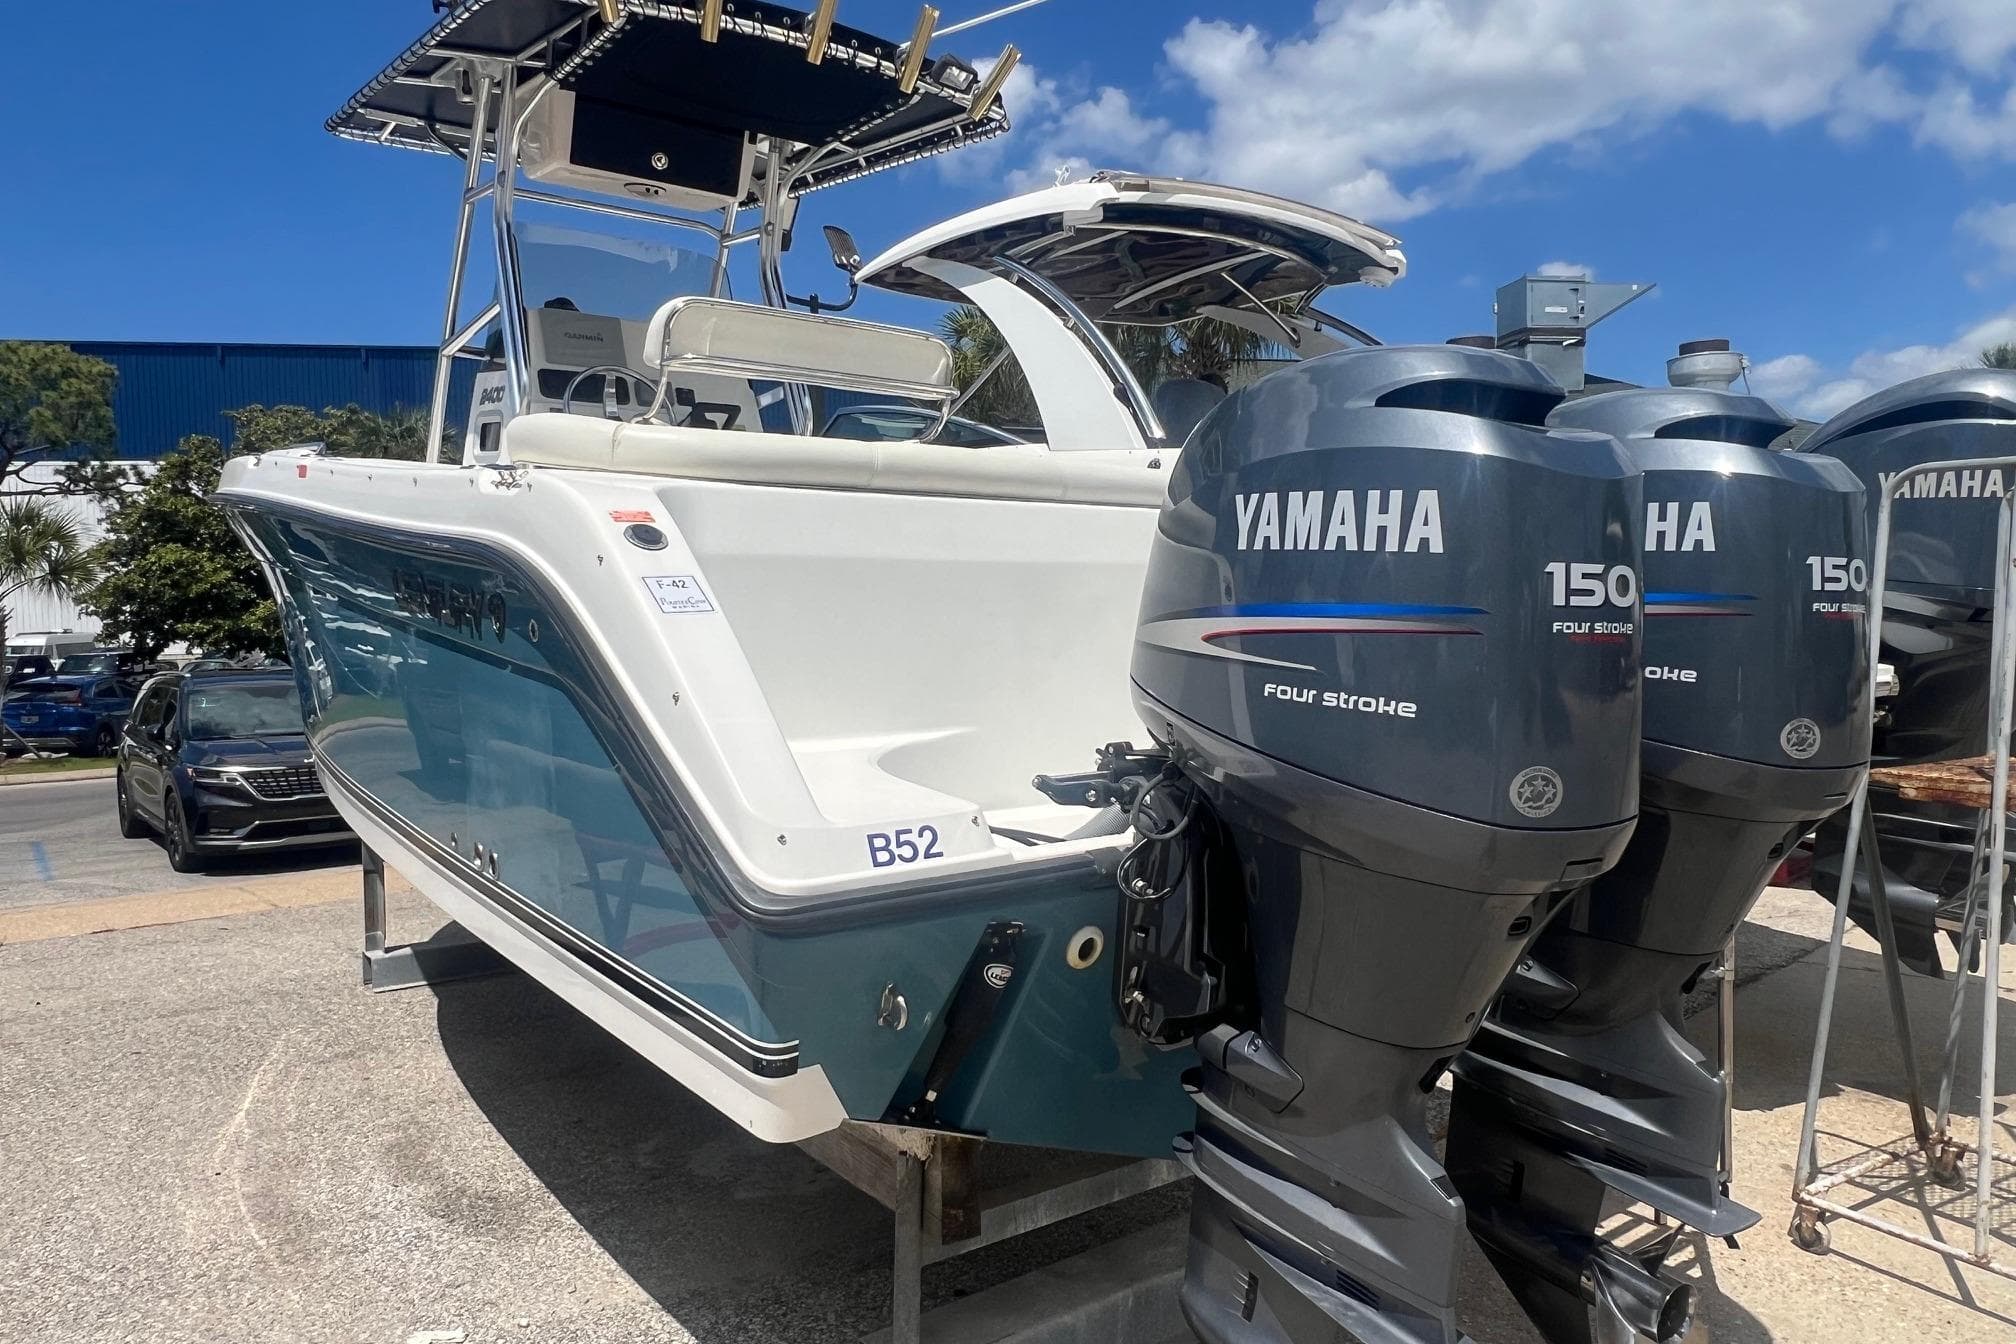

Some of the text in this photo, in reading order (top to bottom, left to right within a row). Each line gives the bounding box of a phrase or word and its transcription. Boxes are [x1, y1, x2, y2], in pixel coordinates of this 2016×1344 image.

[1878, 469, 2004, 499] YAMAHA
[1235, 489, 1443, 554] YAMAHA
[1645, 501, 1716, 552] HA
[656, 579, 689, 589] F-42
[1543, 562, 1637, 608] 150
[1805, 555, 1868, 592] 150
[1644, 666, 1698, 683] oke
[1322, 691, 1418, 718] stroke
[866, 824, 944, 868] B52
